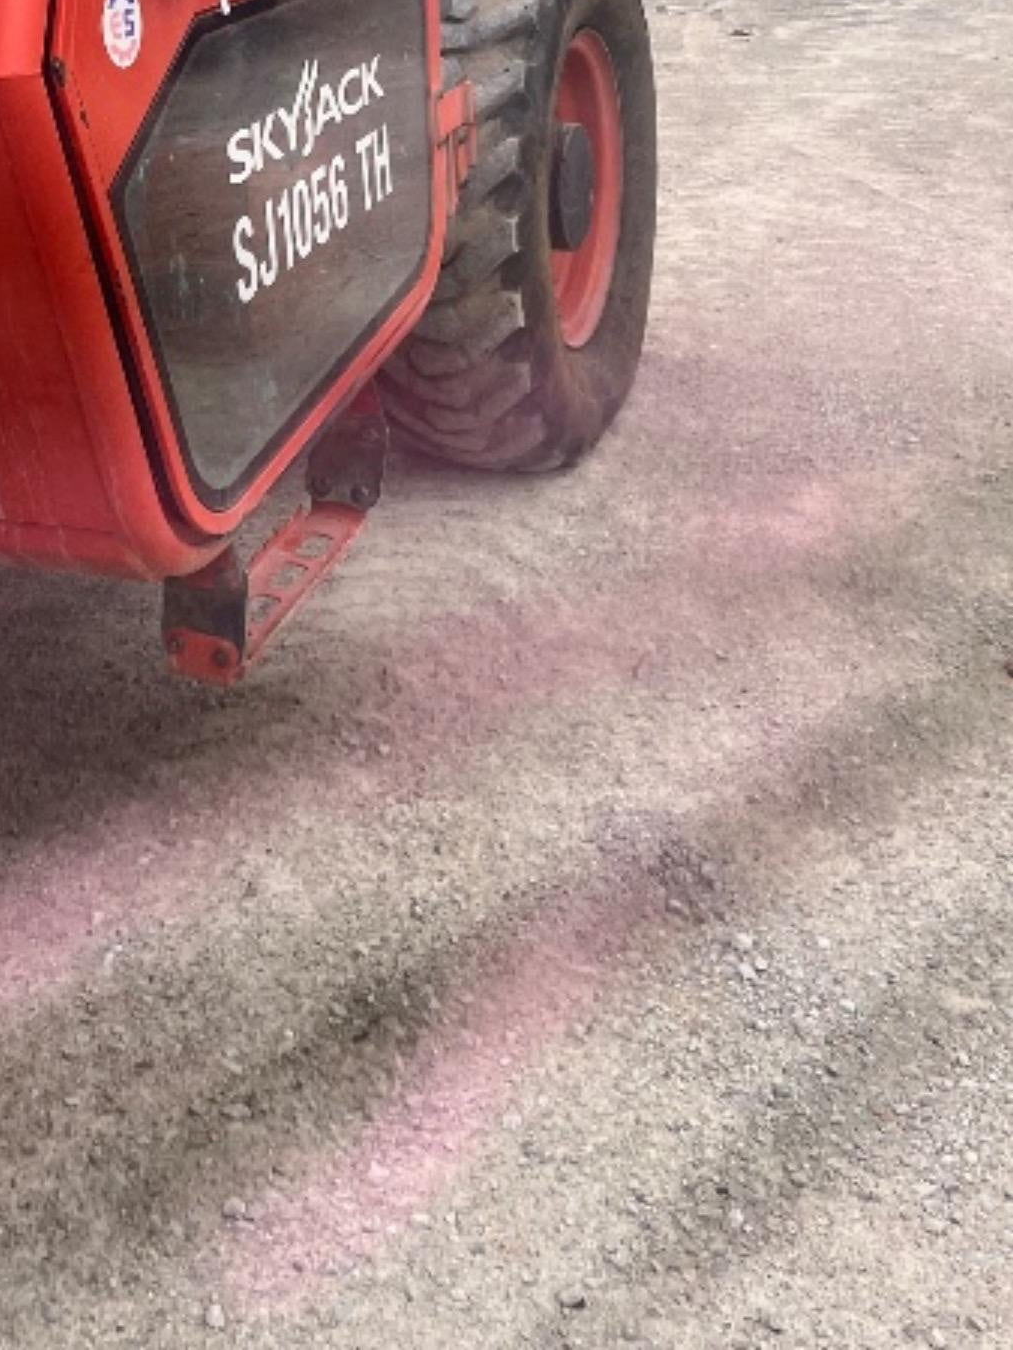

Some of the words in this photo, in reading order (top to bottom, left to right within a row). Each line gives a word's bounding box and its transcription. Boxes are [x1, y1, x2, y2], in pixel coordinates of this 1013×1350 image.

[226, 53, 385, 184] SKYJACK
[232, 153, 349, 303] SJ1056
[355, 122, 394, 211] TH
